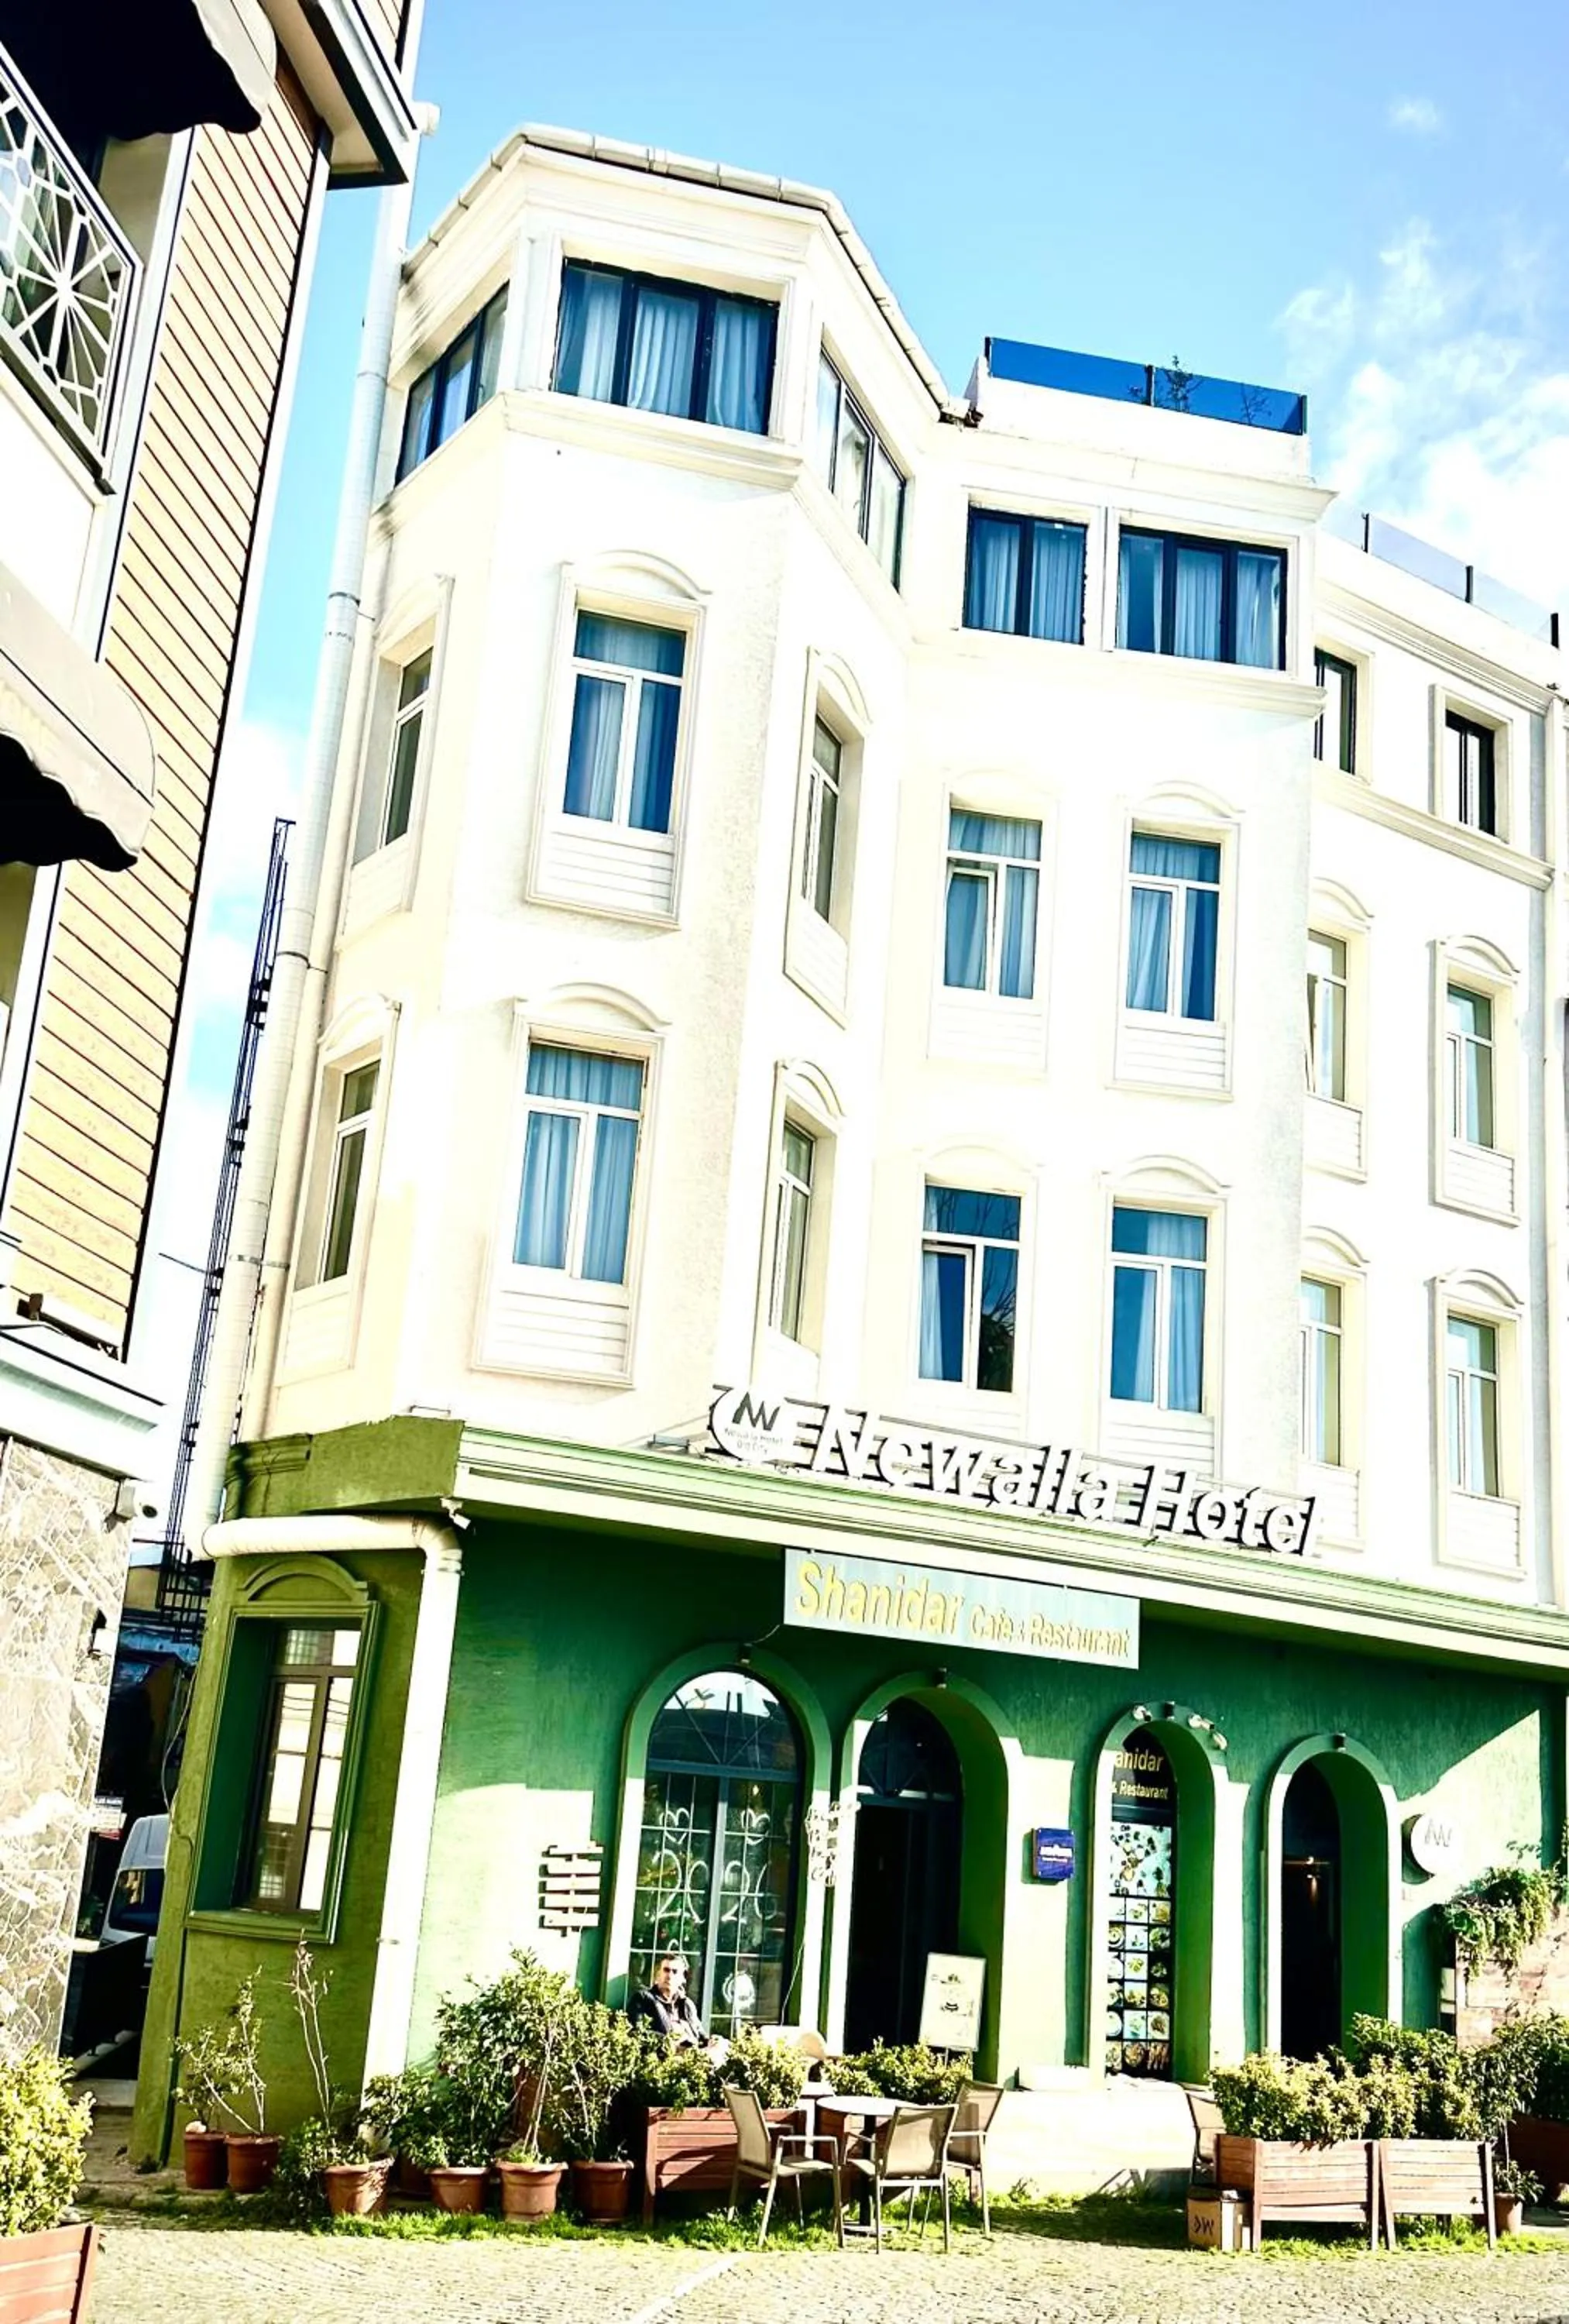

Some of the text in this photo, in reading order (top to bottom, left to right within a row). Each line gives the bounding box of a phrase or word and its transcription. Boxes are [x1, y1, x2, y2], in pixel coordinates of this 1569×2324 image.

[812, 1401, 1327, 1557] Newalla Hotel
[795, 1559, 965, 1635] Shanidar
[1028, 1611, 1130, 1658] Restaurant
[1114, 1748, 1164, 1772] anidar
